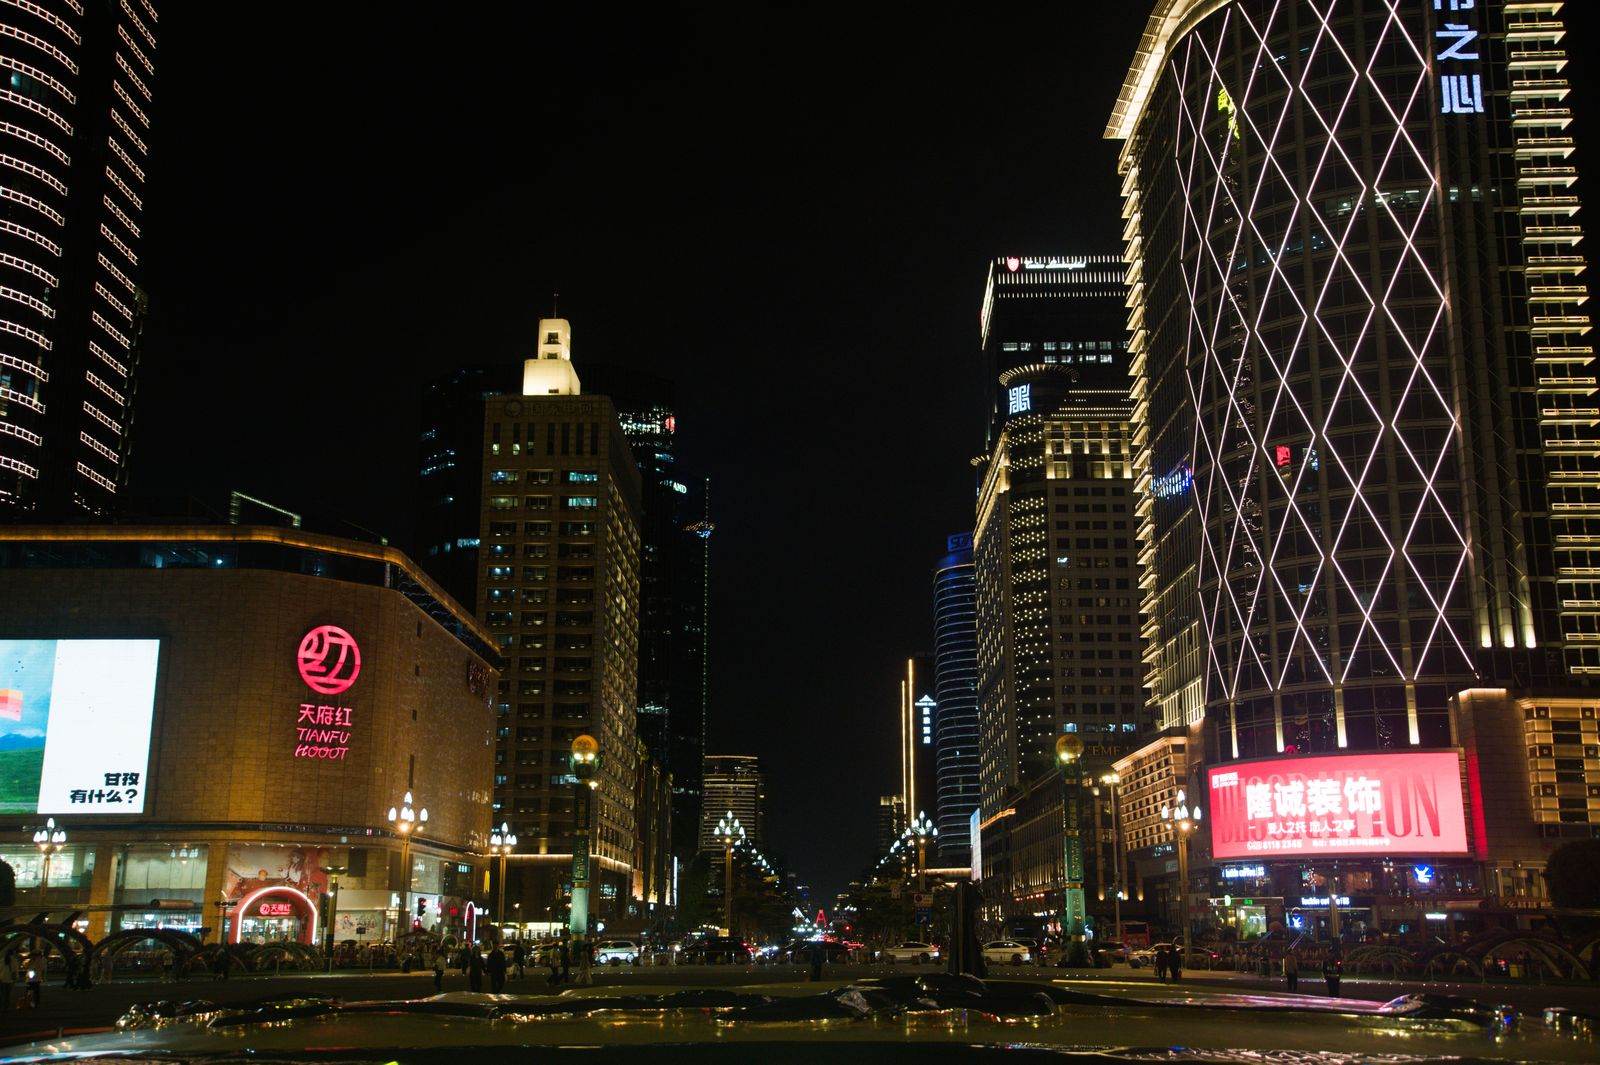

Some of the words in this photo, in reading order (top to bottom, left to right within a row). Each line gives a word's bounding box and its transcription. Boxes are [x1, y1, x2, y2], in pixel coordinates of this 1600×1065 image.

[298, 703, 353, 727] 天府红
[296, 727, 351, 744] TIANFU
[104, 772, 140, 786] 甘孜
[1246, 777, 1382, 820] 隆诚装饰
